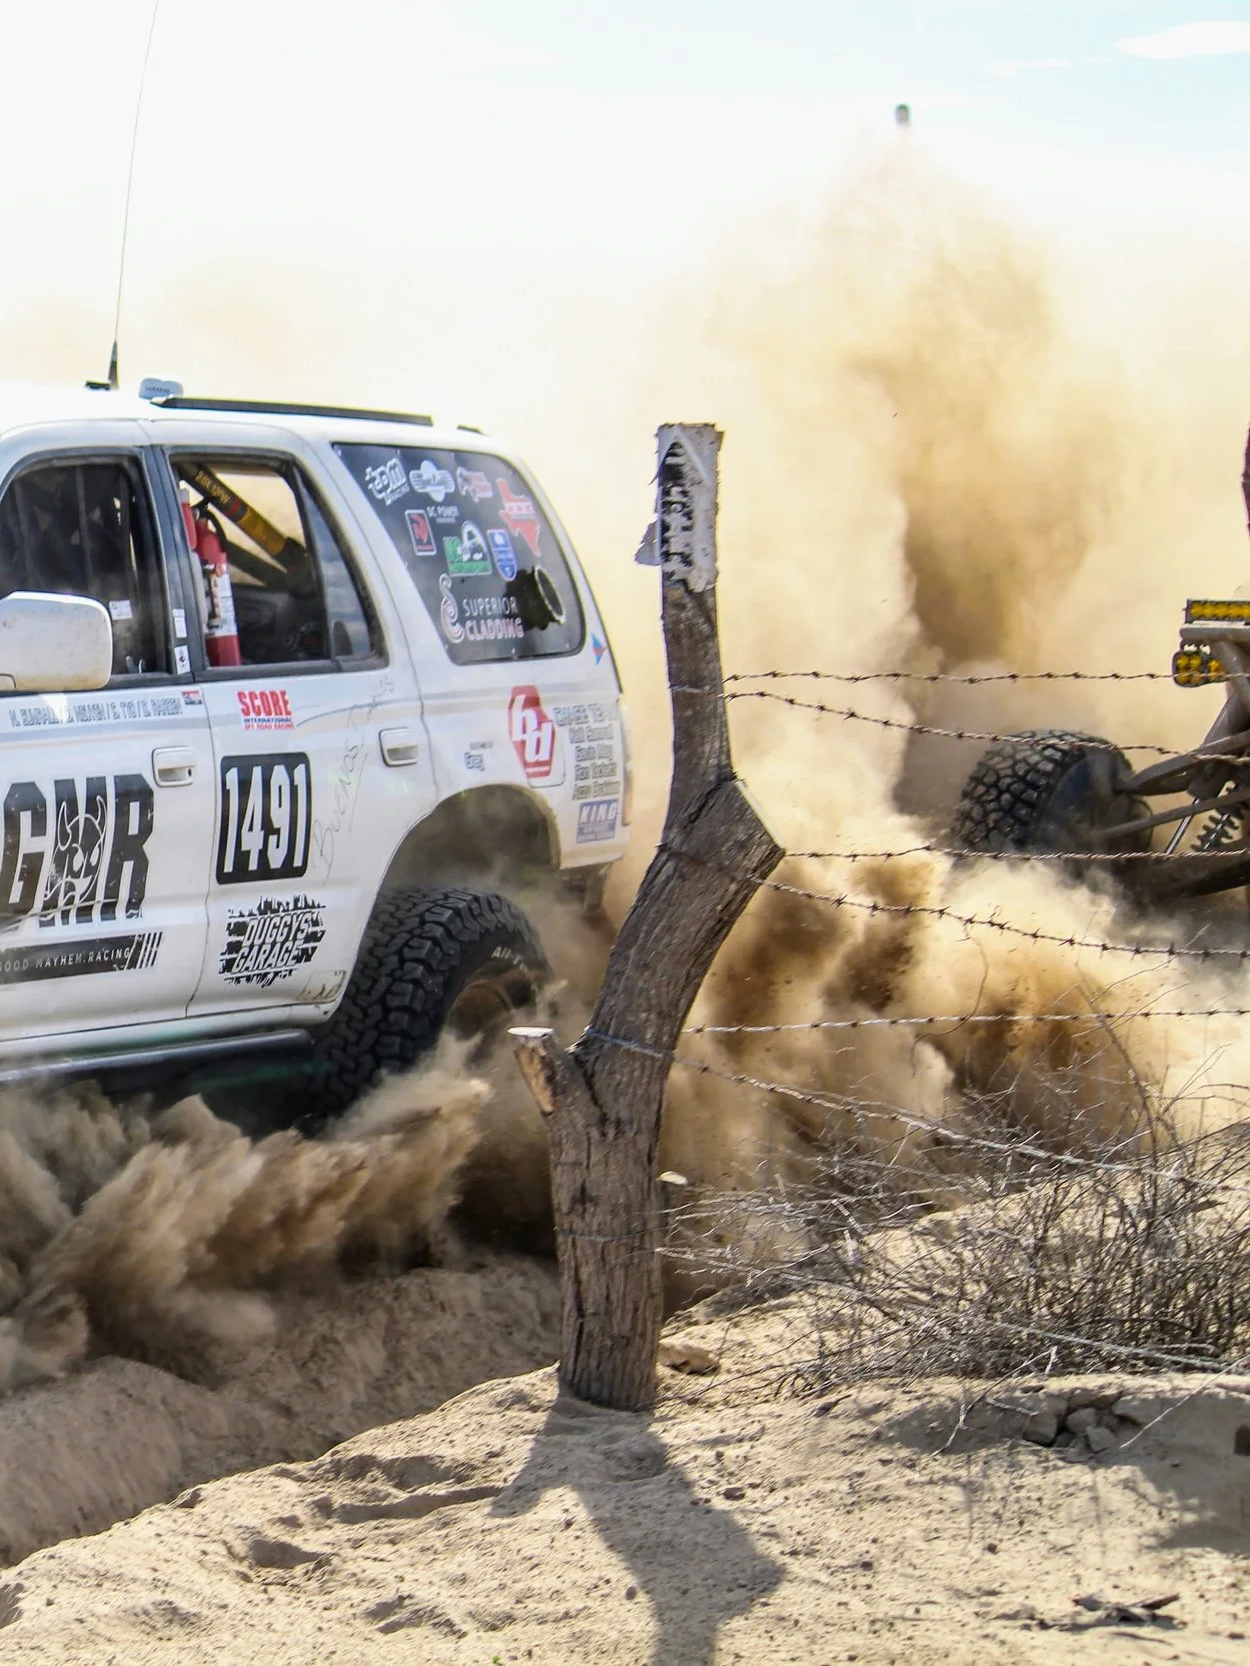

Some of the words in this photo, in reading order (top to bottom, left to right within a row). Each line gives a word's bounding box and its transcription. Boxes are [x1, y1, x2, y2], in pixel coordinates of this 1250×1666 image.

[462, 596, 518, 617] SUPERIOR
[464, 617, 525, 642] CLADDING
[237, 690, 292, 717] SCORE
[223, 763, 307, 873] 1491
[580, 801, 618, 824] KING
[242, 911, 312, 947] DUGGYS
[88, 947, 131, 963] RACING
[231, 940, 304, 975] GARAGE
